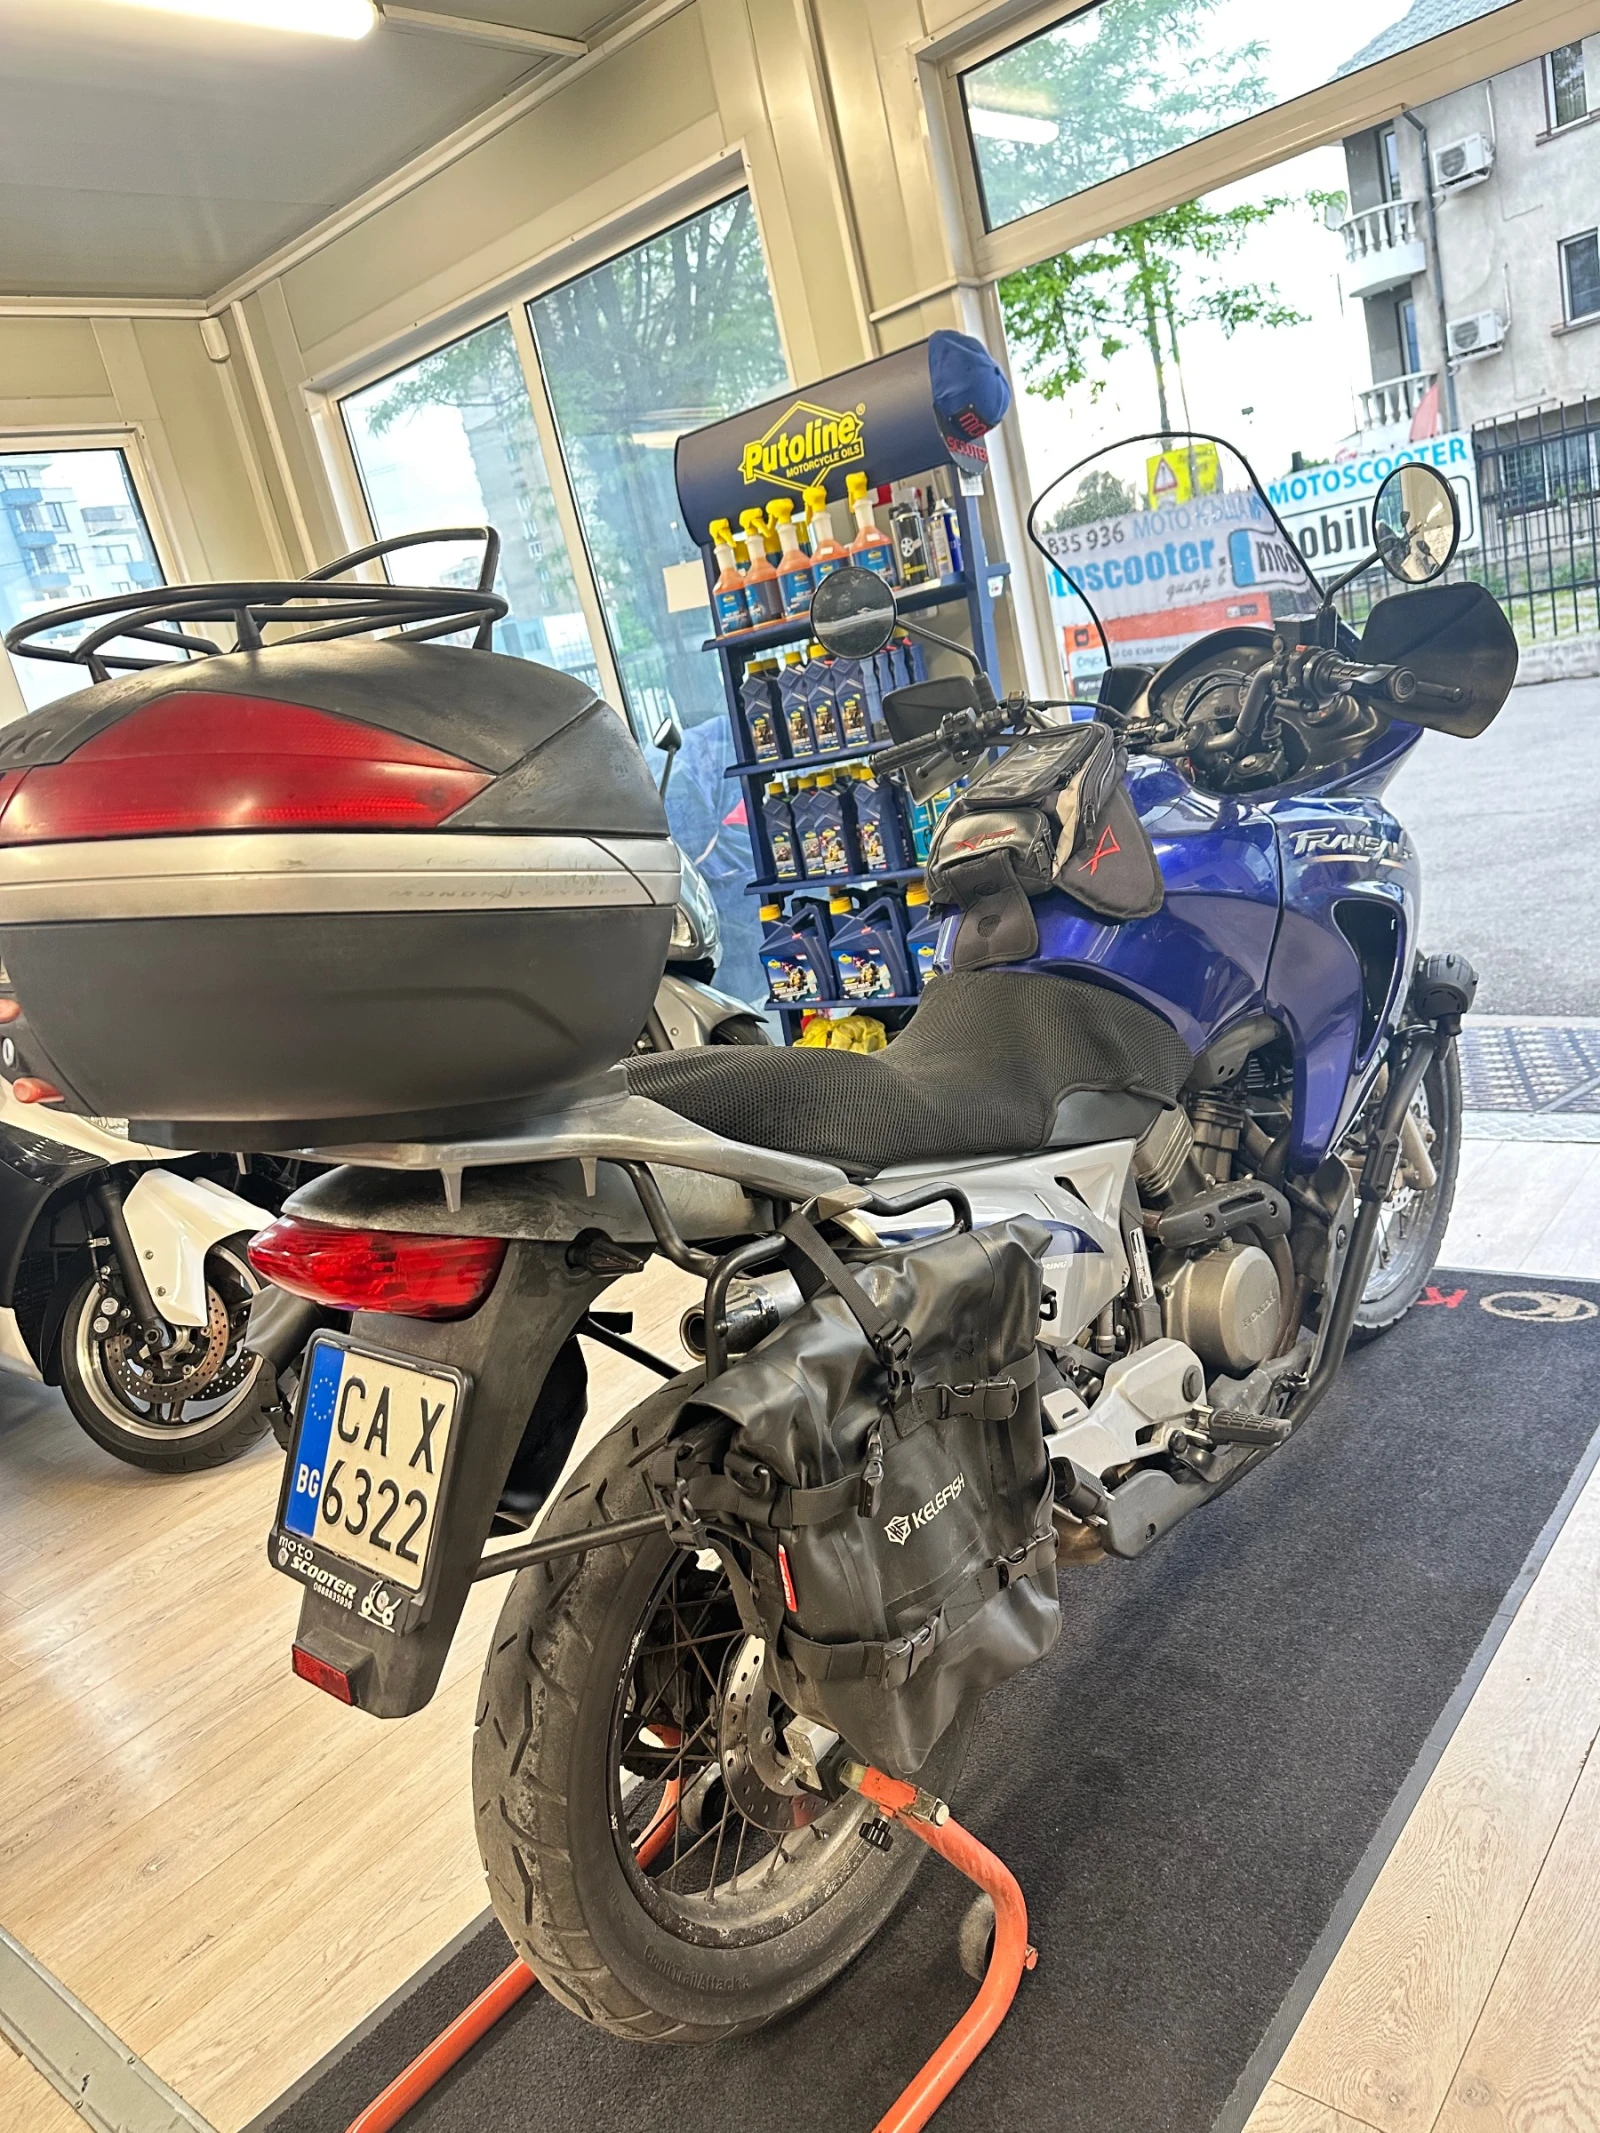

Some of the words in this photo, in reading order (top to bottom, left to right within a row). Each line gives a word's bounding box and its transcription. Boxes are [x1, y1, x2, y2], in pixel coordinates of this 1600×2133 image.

[744, 415, 856, 481] Putoline
[786, 451, 840, 478] MOTORCYCLE
[841, 444, 860, 458] OILS
[1047, 536, 1082, 556] 835
[1086, 522, 1125, 550] 936
[1048, 537, 1215, 598] toscooter
[337, 1377, 390, 1457] CA
[408, 1396, 446, 1474] X
[295, 1463, 321, 1498] BG
[911, 1472, 965, 1529] KELEFISH
[321, 1460, 428, 1564] 6322
[278, 1535, 314, 1562] moto
[290, 1556, 357, 1600] SCOOTER
